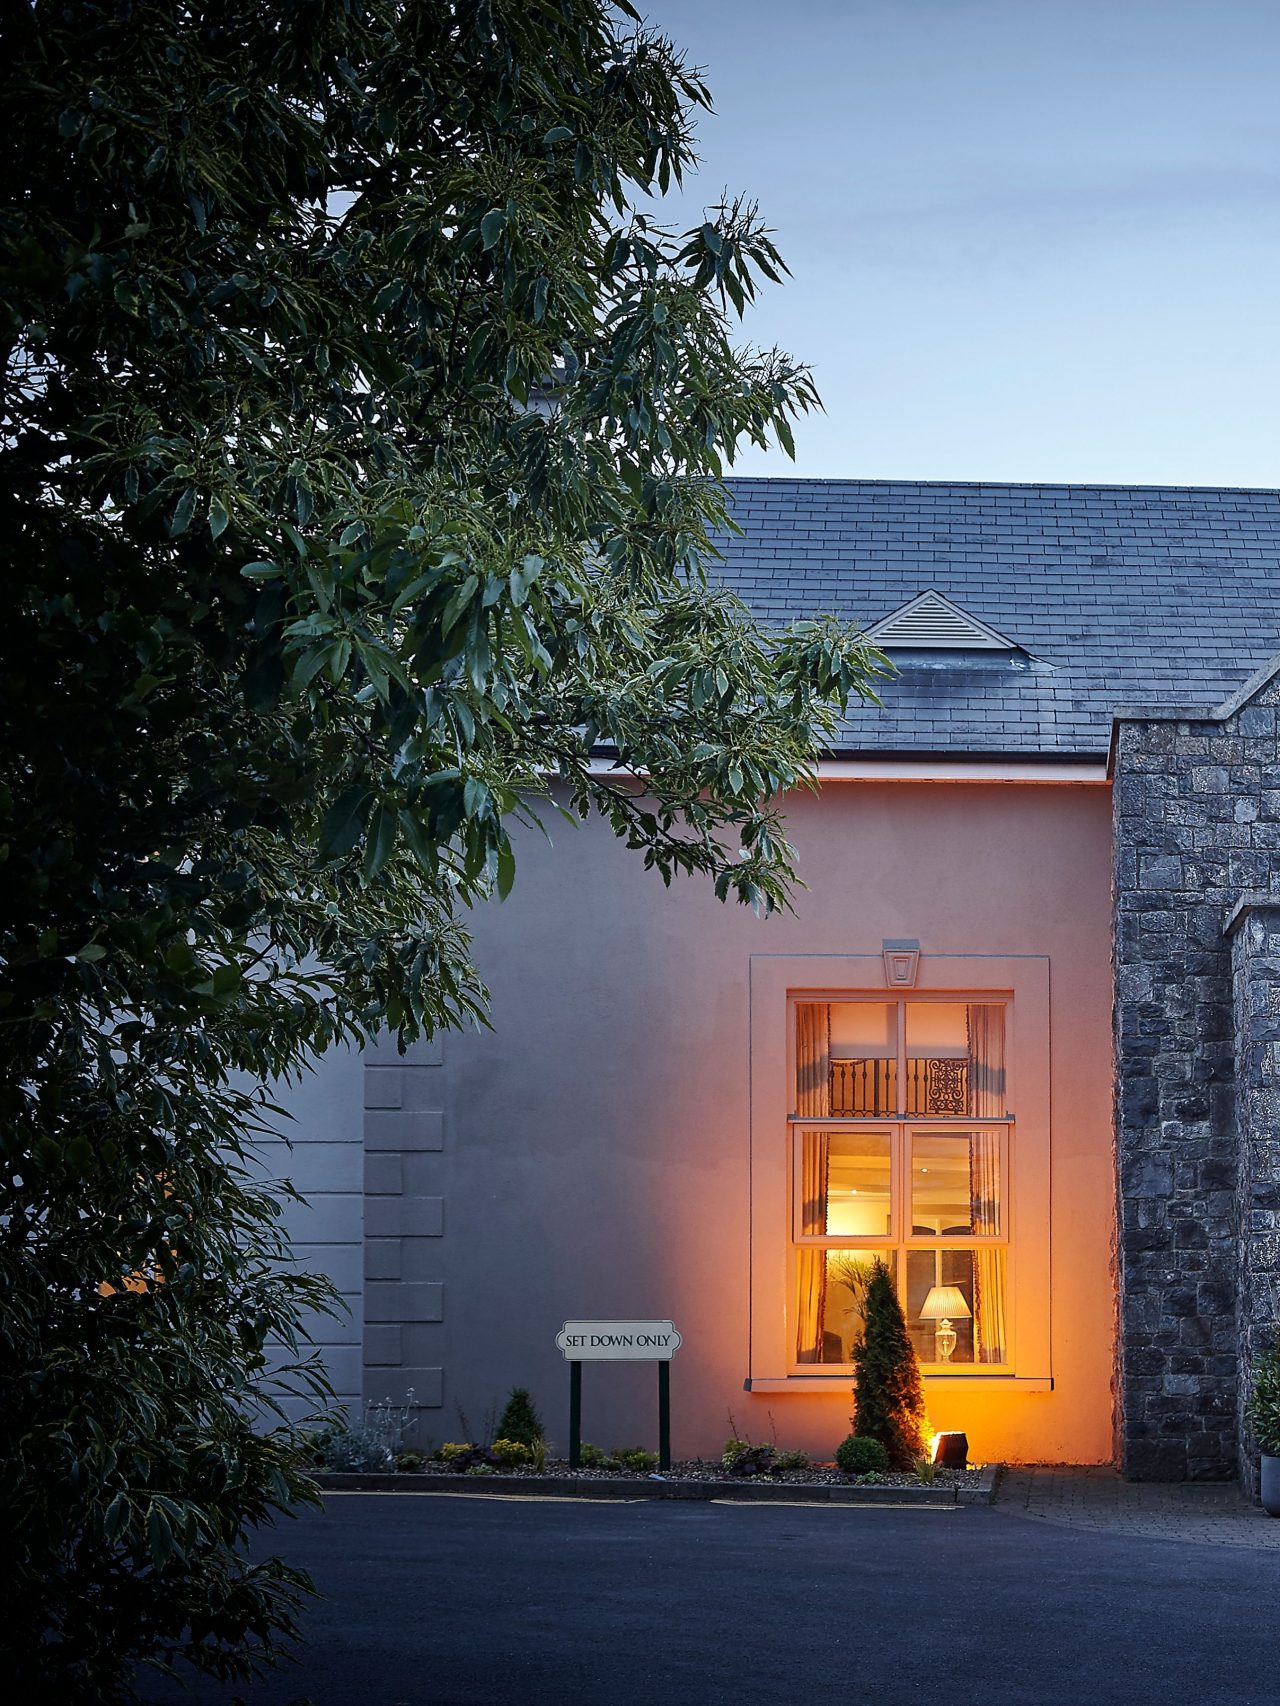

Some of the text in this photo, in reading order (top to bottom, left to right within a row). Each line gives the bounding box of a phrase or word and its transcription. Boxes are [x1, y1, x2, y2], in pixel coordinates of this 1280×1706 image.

[566, 1335, 670, 1346] SET DOWN ONLY
